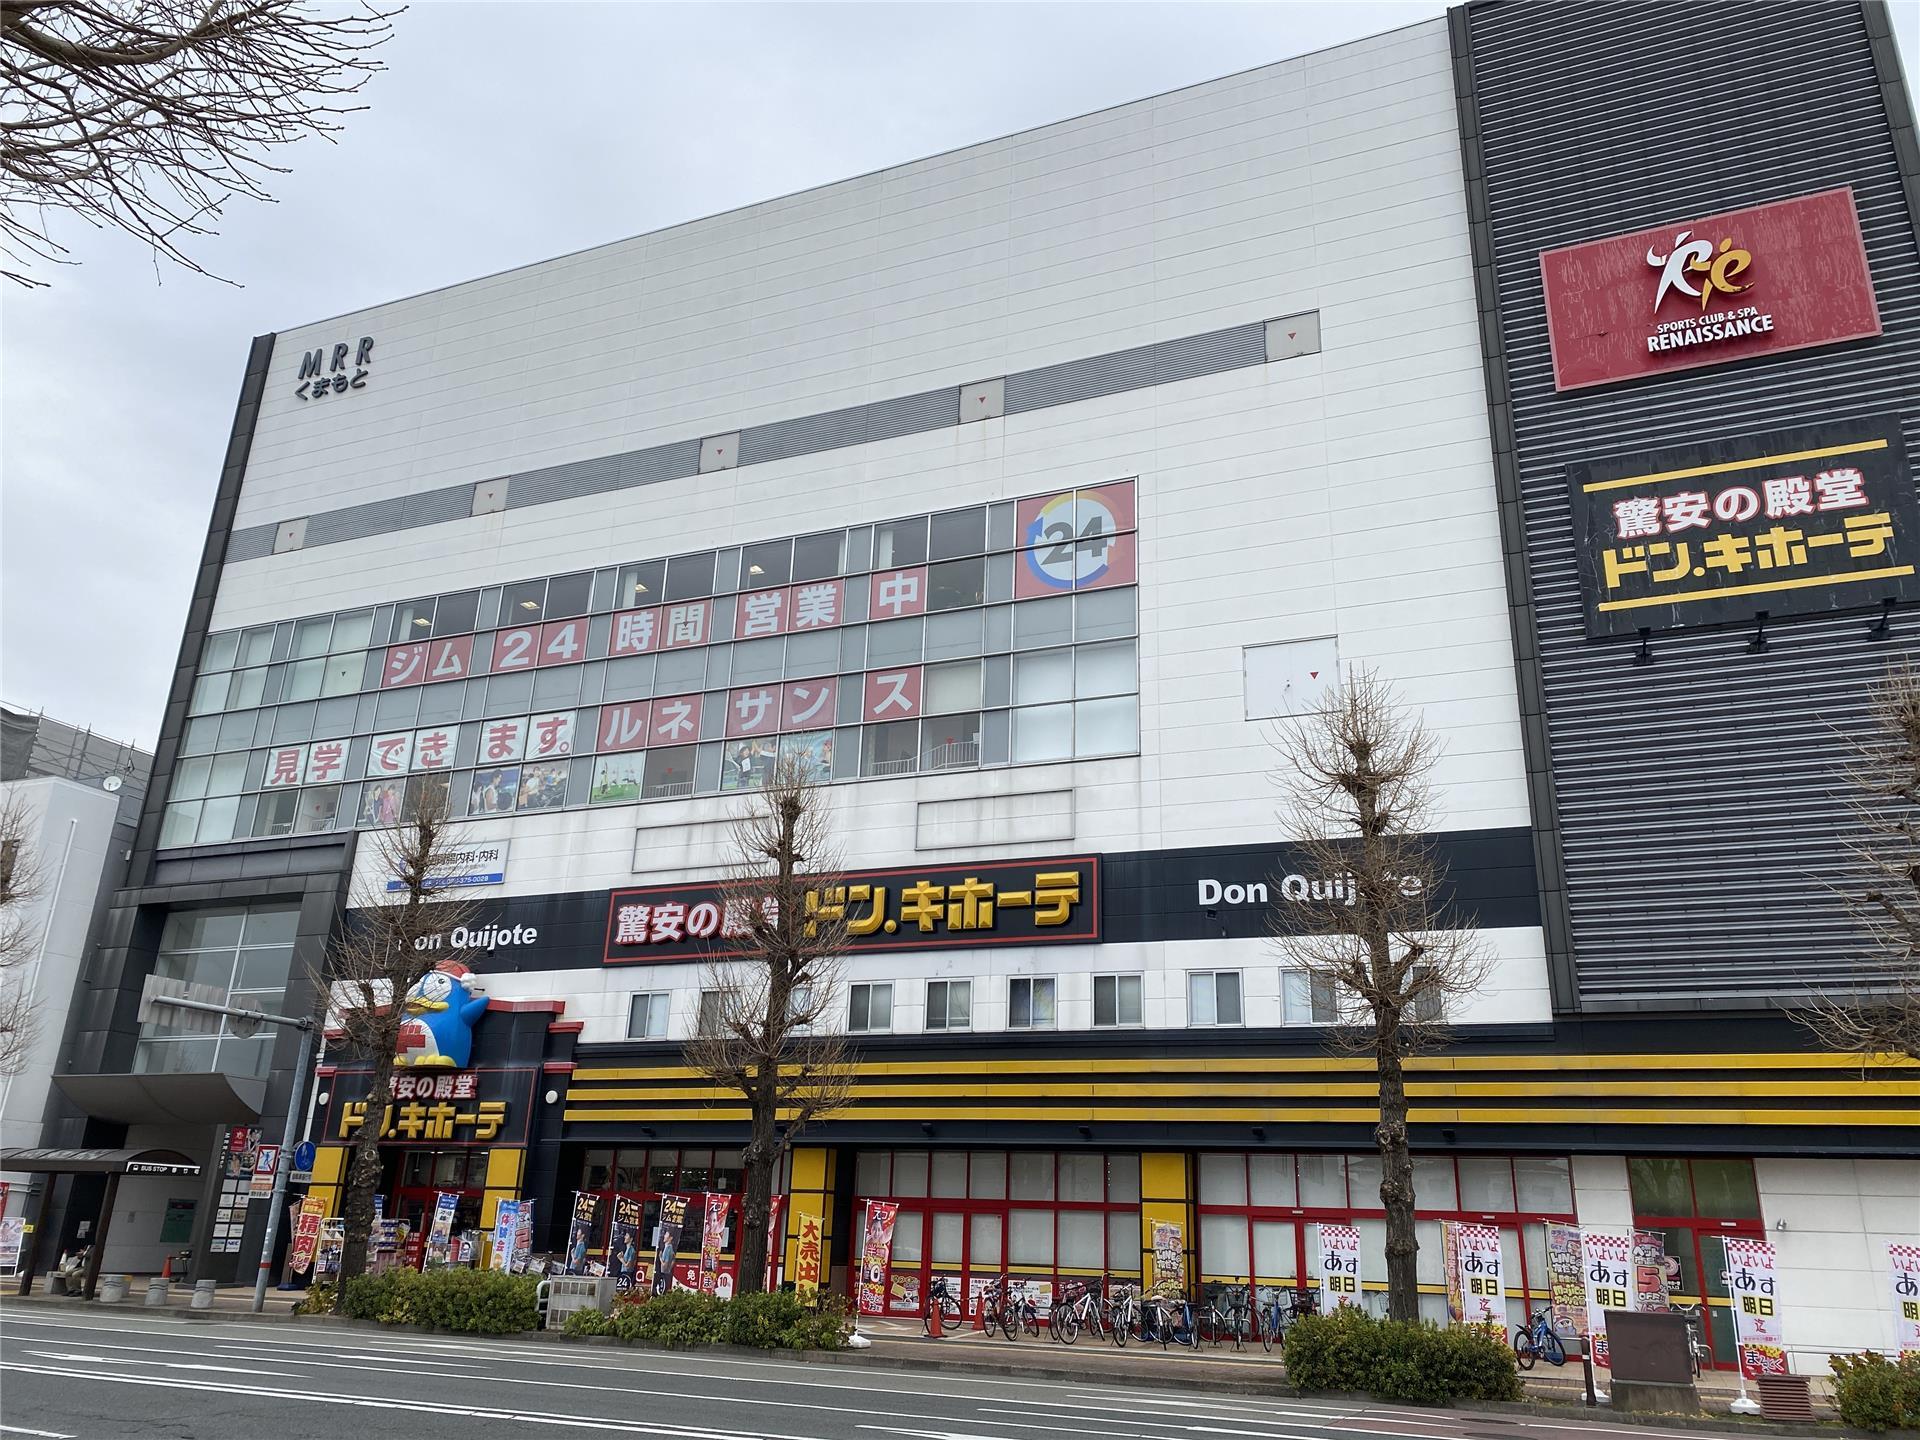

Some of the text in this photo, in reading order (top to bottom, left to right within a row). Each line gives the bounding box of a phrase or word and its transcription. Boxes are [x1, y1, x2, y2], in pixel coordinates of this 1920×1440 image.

[1657, 306, 1758, 334] SPORTS CLUB & SPA
[1647, 314, 1774, 352] RENAISSANCE
[298, 336, 374, 380] MRR
[294, 368, 369, 401] くまもと
[1613, 468, 1869, 540] 驚安の殿堂
[1042, 515, 1109, 565] 24
[604, 673, 913, 747] ルネサンス
[1198, 871, 1423, 906] Don Quije
[398, 924, 538, 951] on Quijote
[1323, 1238, 1358, 1251] いよいよ
[1462, 1239, 1498, 1253] いよいよ
[1587, 1246, 1628, 1263] いよいよ
[1324, 1250, 1359, 1275] あす
[1464, 1252, 1501, 1277] あす
[1731, 1253, 1774, 1270] いよいよ
[616, 1277, 628, 1287] 24
[1329, 1276, 1356, 1293] 明日
[1470, 1278, 1498, 1296] 明日
[1589, 1261, 1630, 1288] あす
[1735, 1267, 1777, 1296] あす
[1596, 1288, 1627, 1307] 明日
[1742, 1296, 1774, 1316] 明日
[1754, 1319, 1767, 1334] 迄
